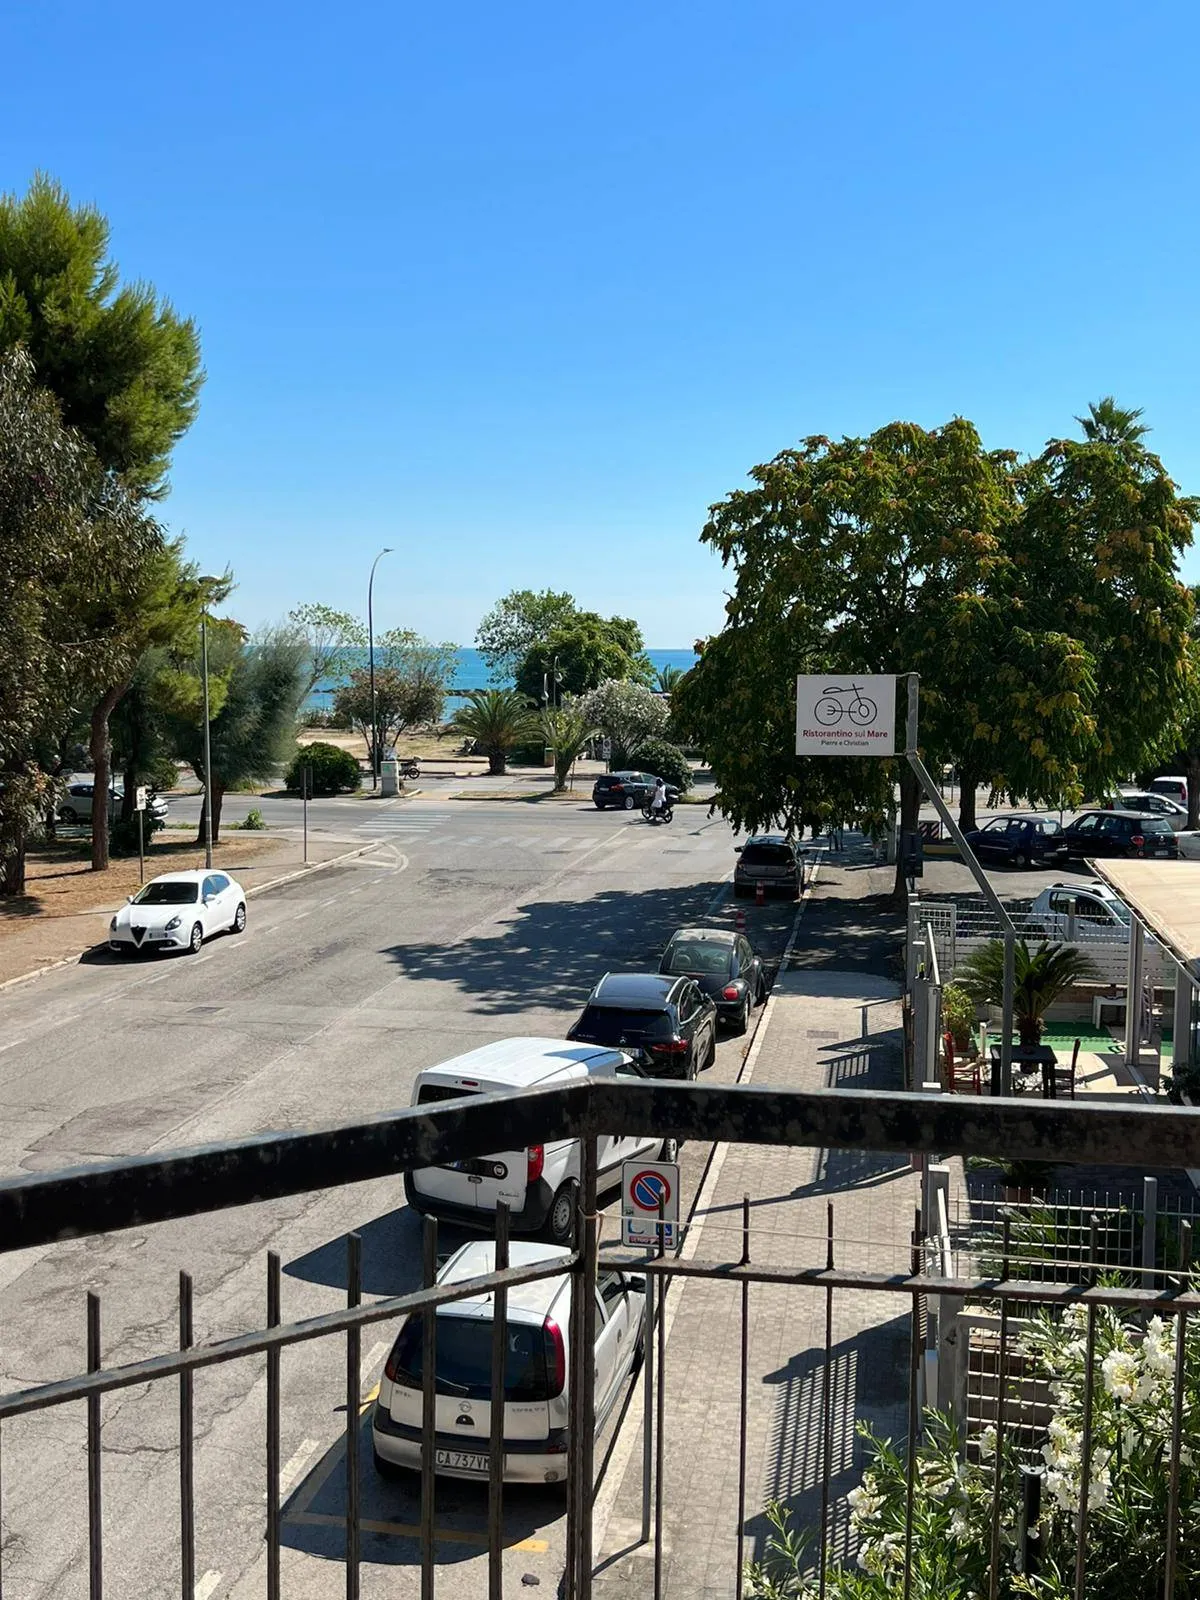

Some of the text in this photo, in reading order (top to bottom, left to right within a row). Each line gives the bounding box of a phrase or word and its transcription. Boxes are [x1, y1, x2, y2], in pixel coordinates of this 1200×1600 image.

[803, 729, 888, 738] Ristorantino sul Mare
